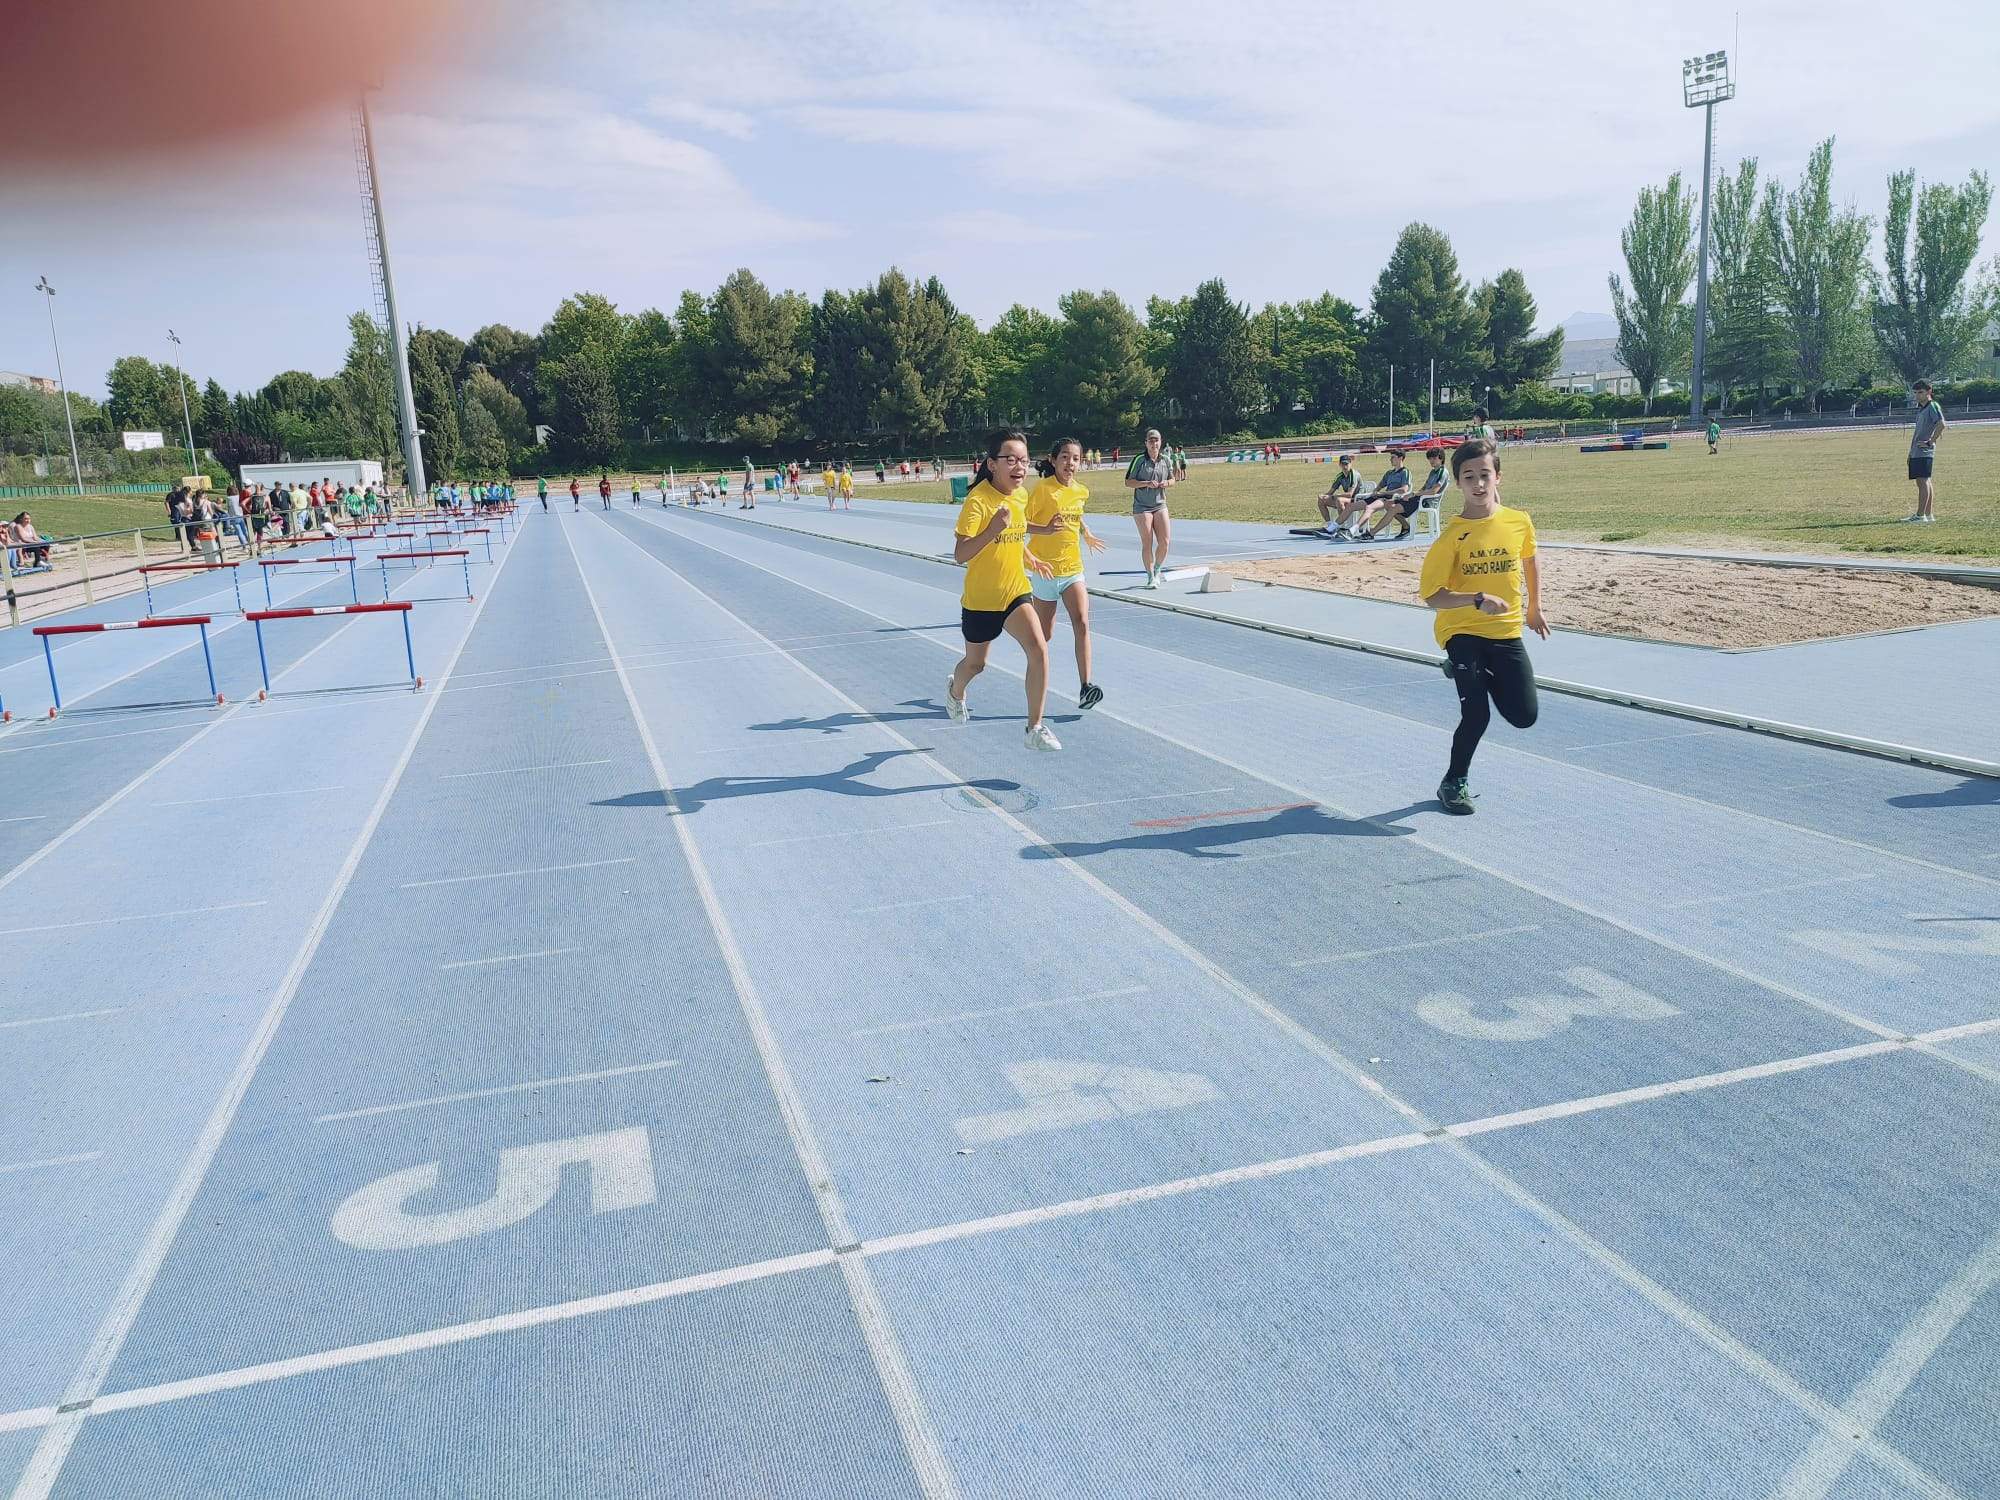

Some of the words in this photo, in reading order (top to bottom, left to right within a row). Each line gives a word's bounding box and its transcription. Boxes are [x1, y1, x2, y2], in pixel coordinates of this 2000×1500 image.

[1462, 562, 1489, 575] SANCHO
[1416, 965, 1681, 1041] 3
[953, 1058, 1218, 1144] 4
[330, 1125, 656, 1250] 5
